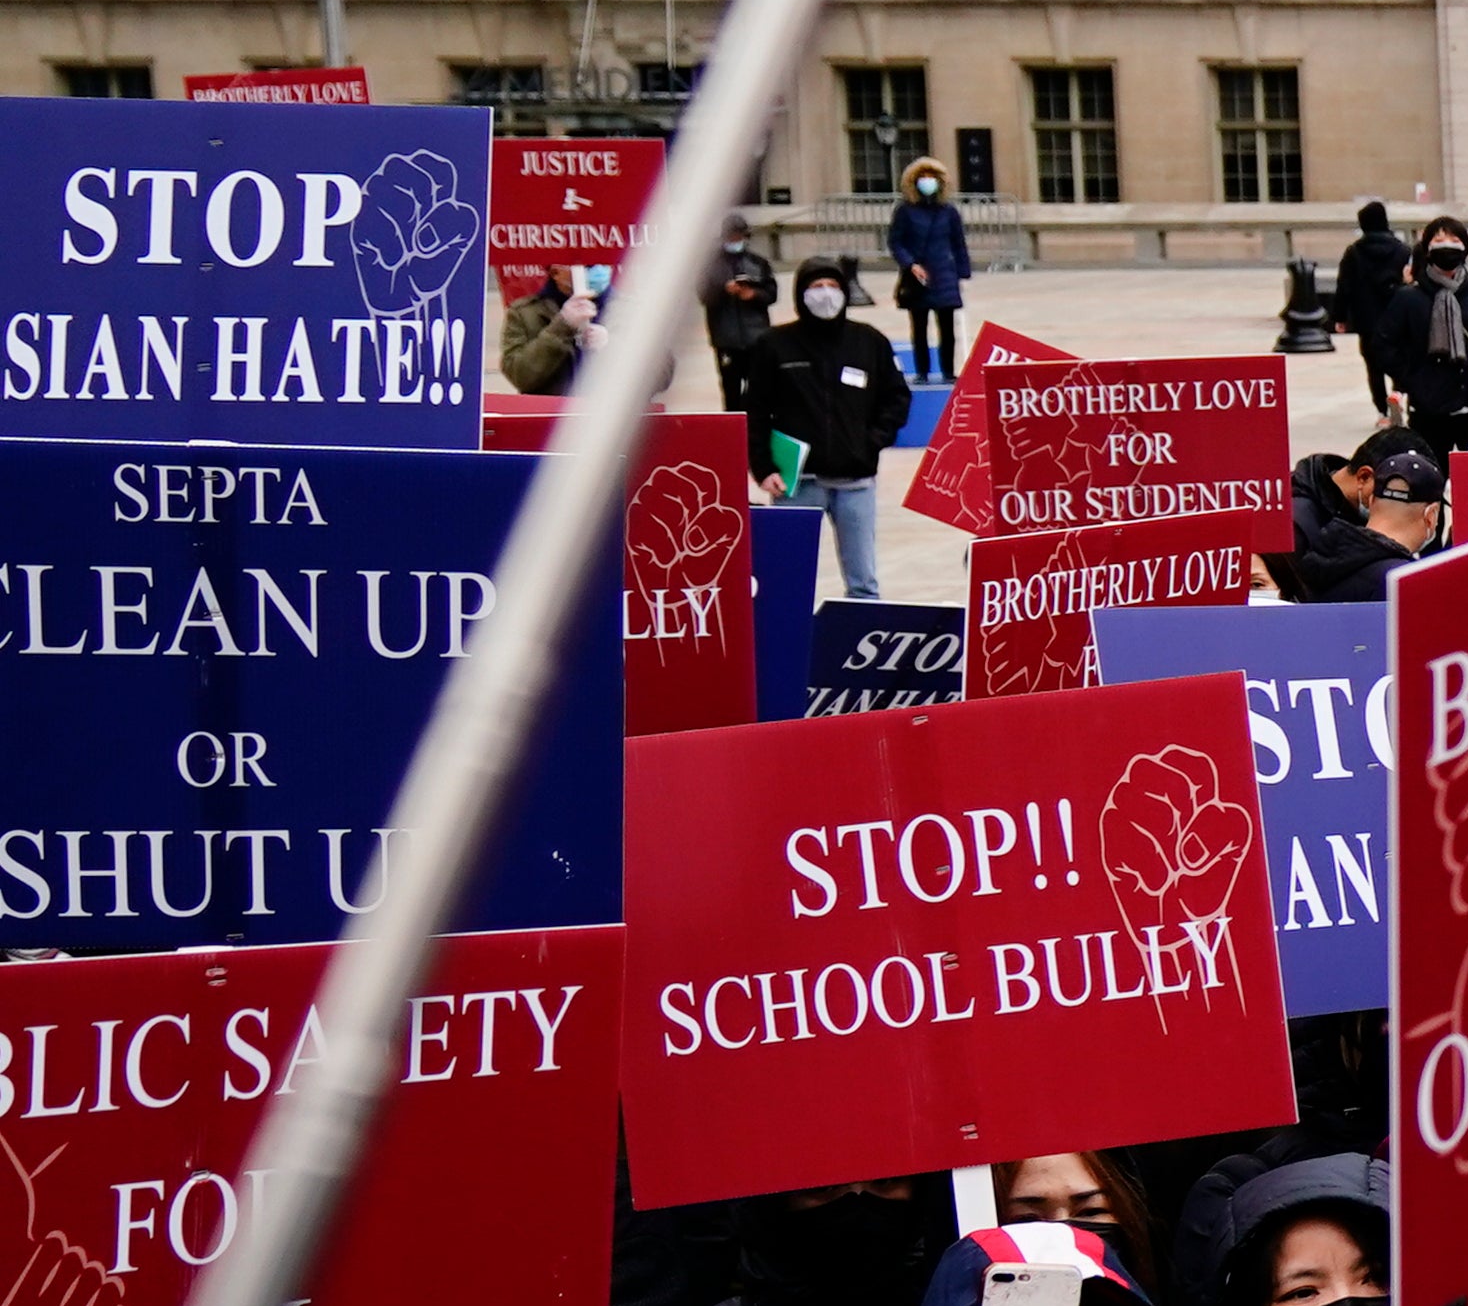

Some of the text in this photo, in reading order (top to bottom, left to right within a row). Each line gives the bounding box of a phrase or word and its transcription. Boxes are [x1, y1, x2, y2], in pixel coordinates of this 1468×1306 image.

[310, 80, 364, 104] LOVE
[519, 150, 620, 177] JUSTICE
[62, 166, 363, 268] STOP
[488, 222, 624, 249] CHRISTINA
[211, 316, 467, 406] HATE!!
[997, 378, 1277, 422] BROTHERLY LOVE
[1108, 432, 1176, 468] FOR
[112, 463, 328, 527] SEPTA
[1000, 478, 1286, 525] OUR STUDENTS!!
[0, 563, 500, 660] LEAN UP
[980, 545, 1243, 629] BROTHERLY LOVE
[842, 629, 966, 674] STO
[176, 730, 278, 789] OR
[0, 826, 405, 919] SHUT U
[785, 797, 1081, 920] STOP!!
[658, 915, 1234, 1059] SCHOOL BULLY
[0, 983, 584, 1120] LIC SAETY
[108, 1168, 282, 1276] FO
